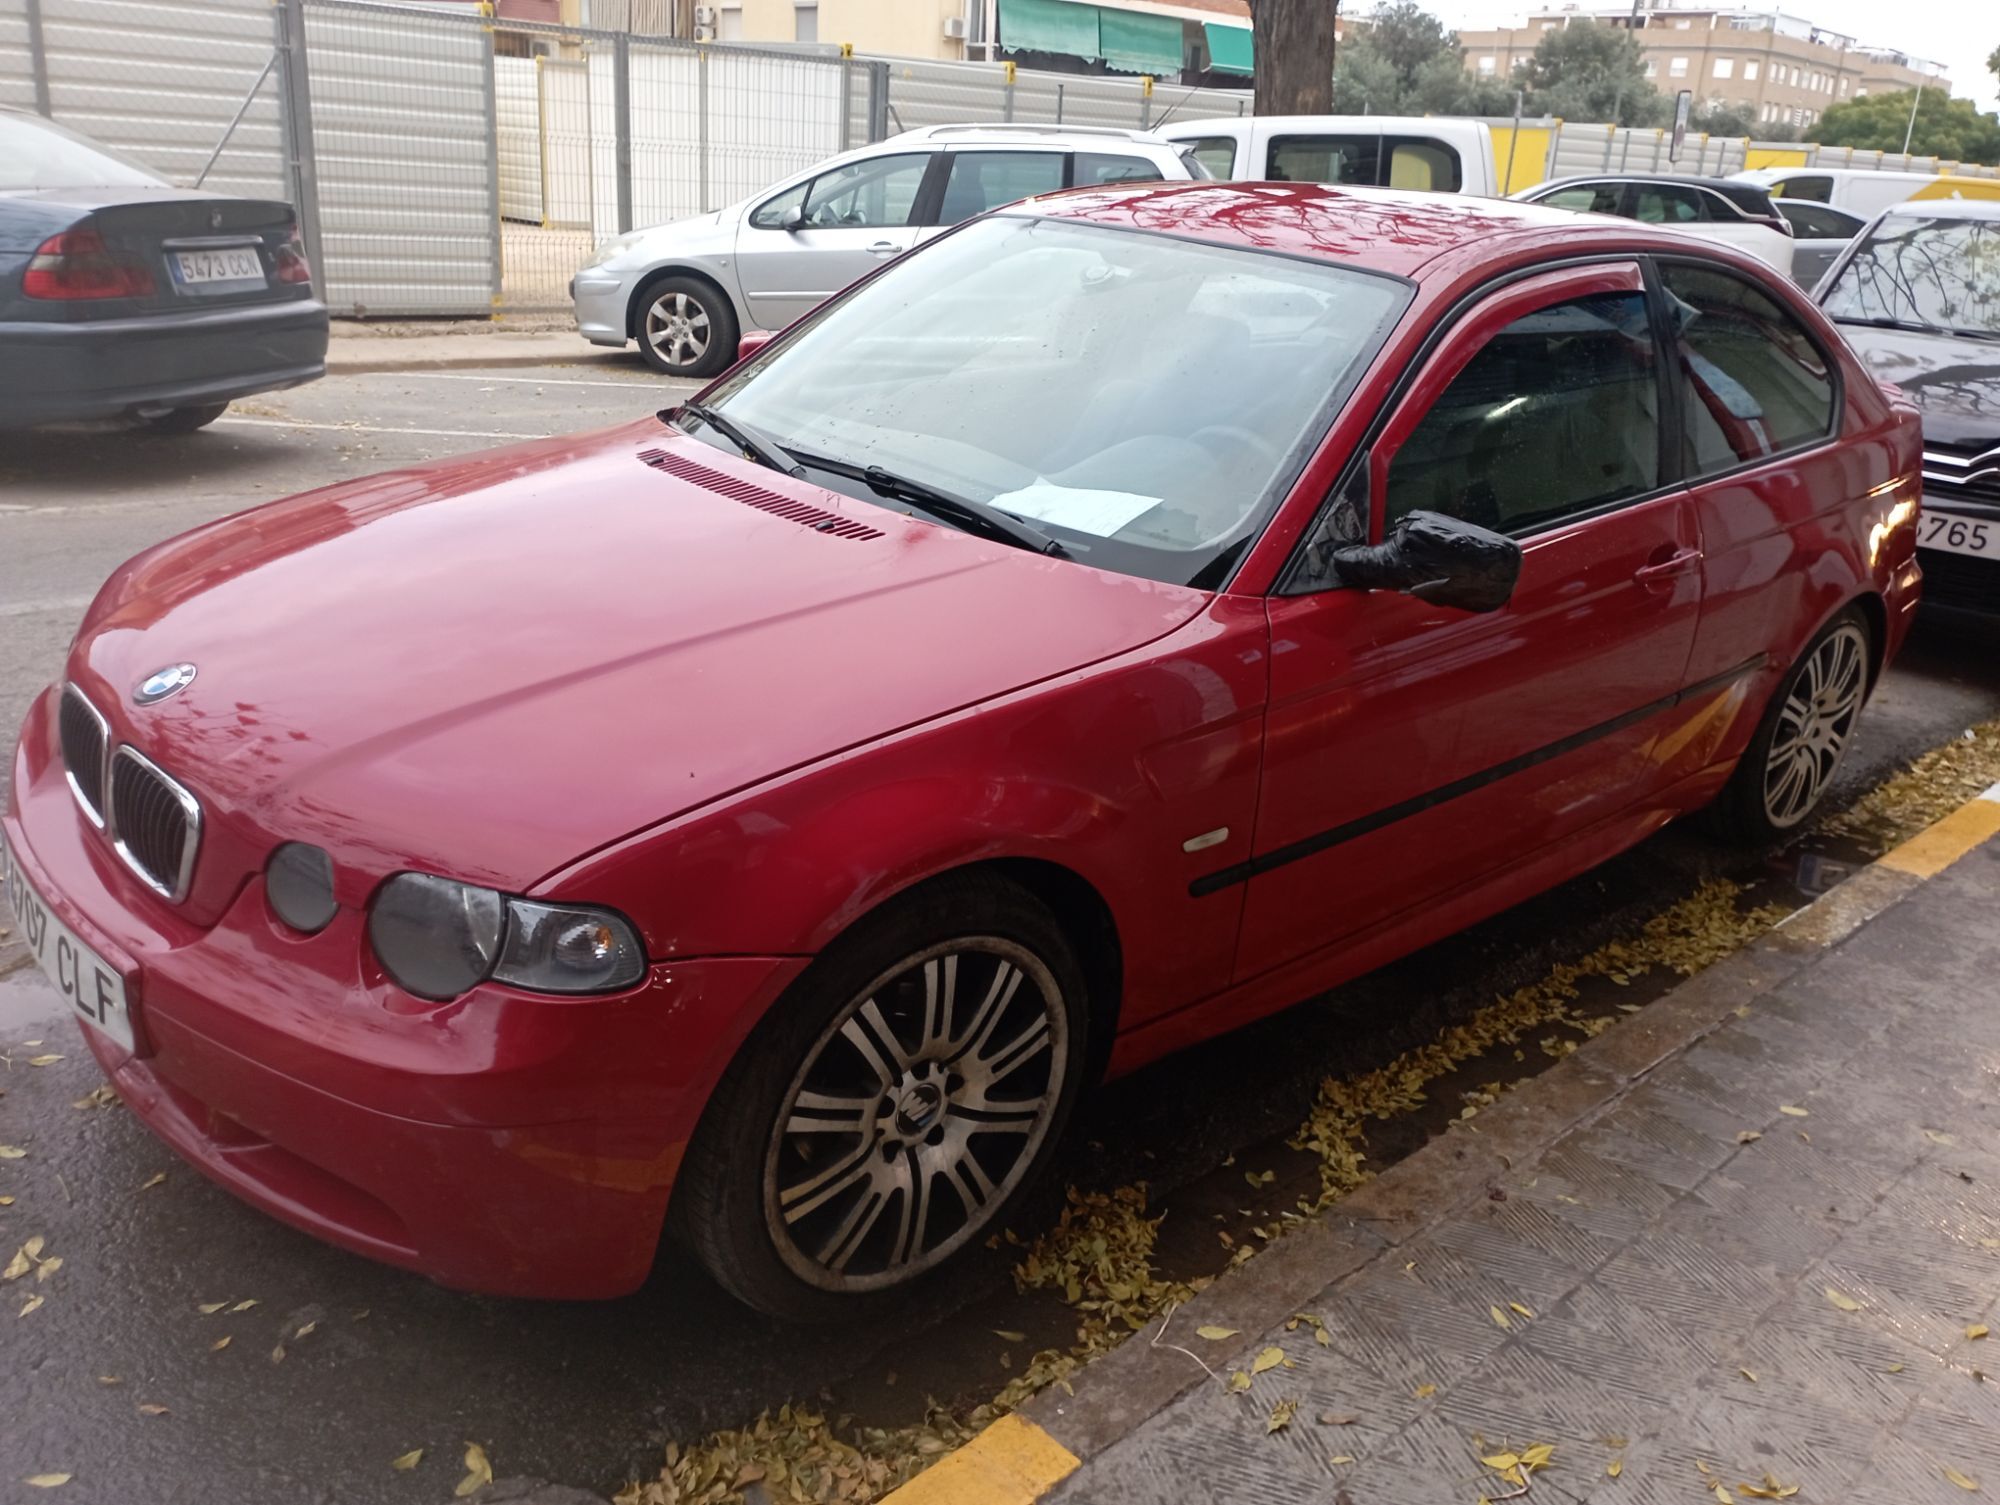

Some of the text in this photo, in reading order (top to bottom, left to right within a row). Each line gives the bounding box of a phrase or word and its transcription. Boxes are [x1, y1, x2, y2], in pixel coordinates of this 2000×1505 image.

[180, 254, 226, 279] 5473
[1917, 513, 1988, 551] 765
[57, 935, 114, 1024] CLF
